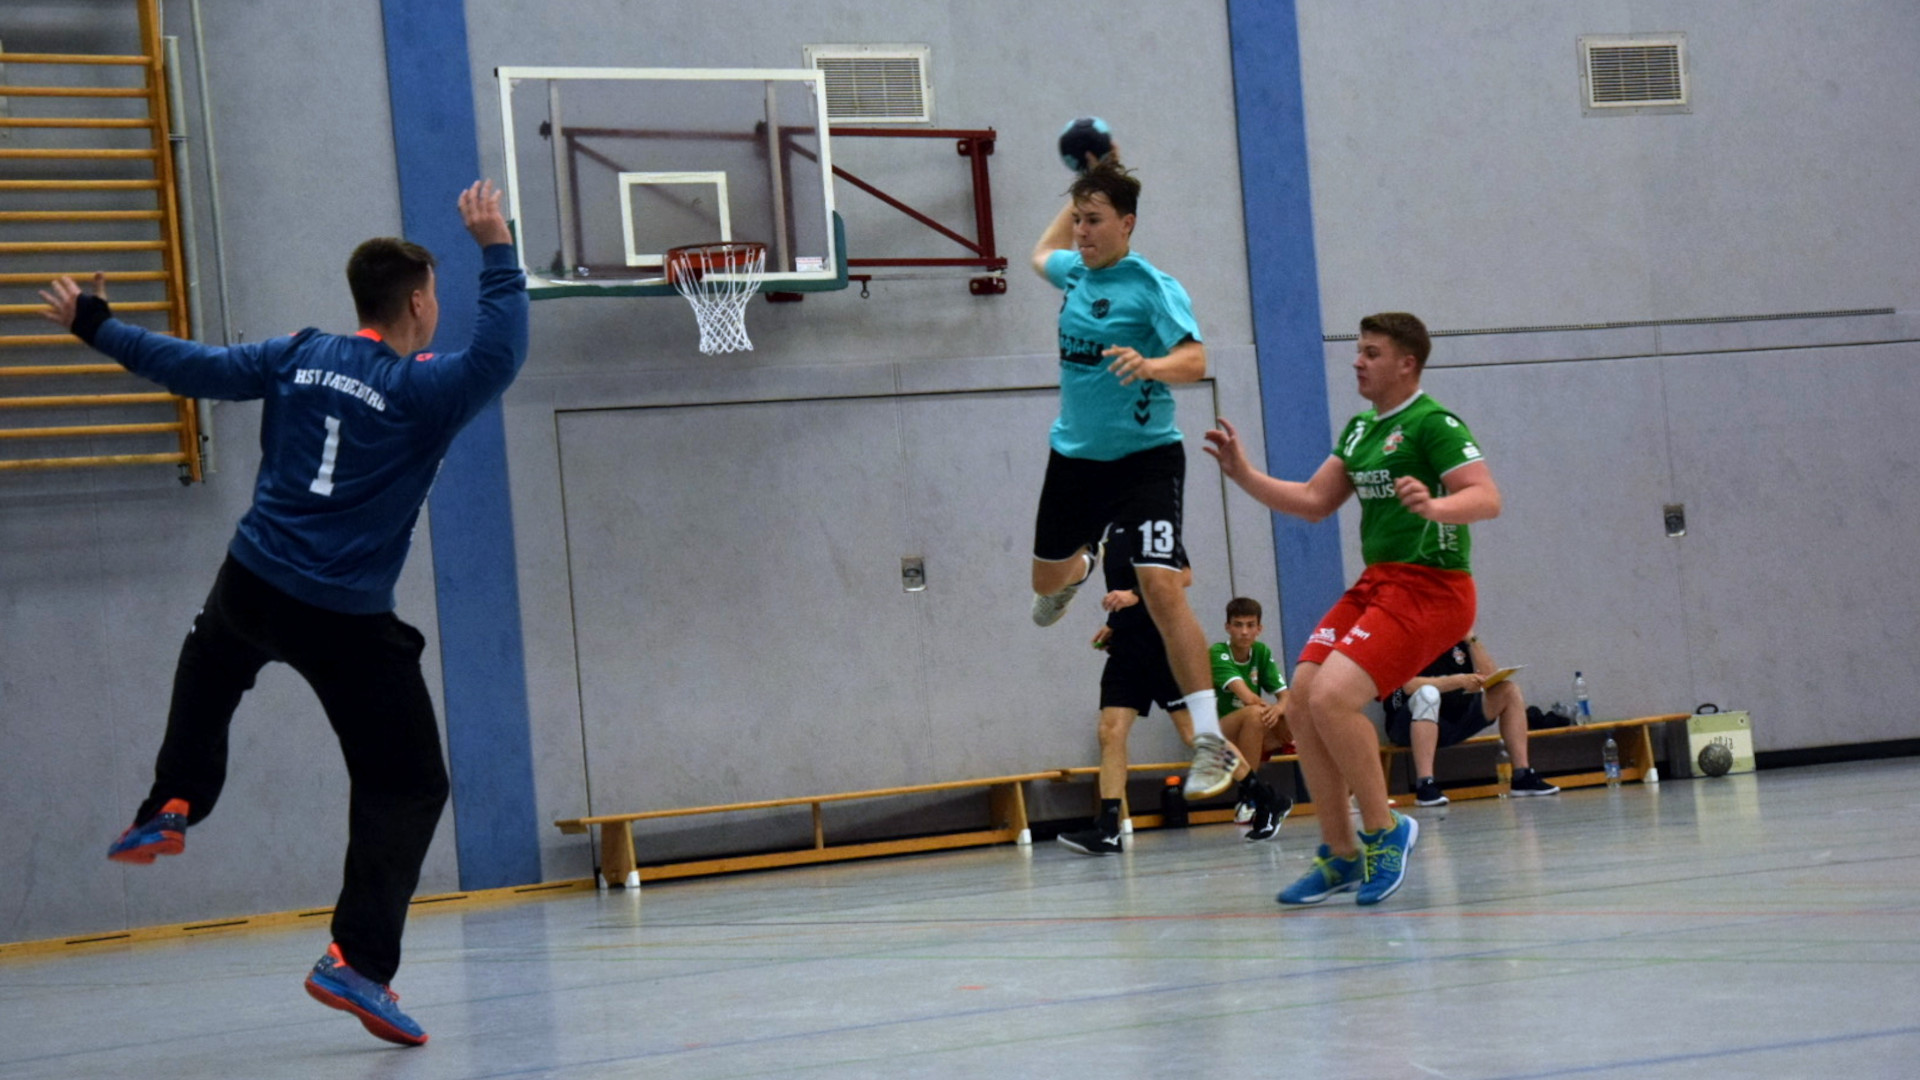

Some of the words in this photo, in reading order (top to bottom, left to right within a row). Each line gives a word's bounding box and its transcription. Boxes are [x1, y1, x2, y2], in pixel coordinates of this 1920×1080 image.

[294, 368, 323, 385] HSV
[309, 415, 341, 497] 1
[1138, 519, 1175, 553] 13
